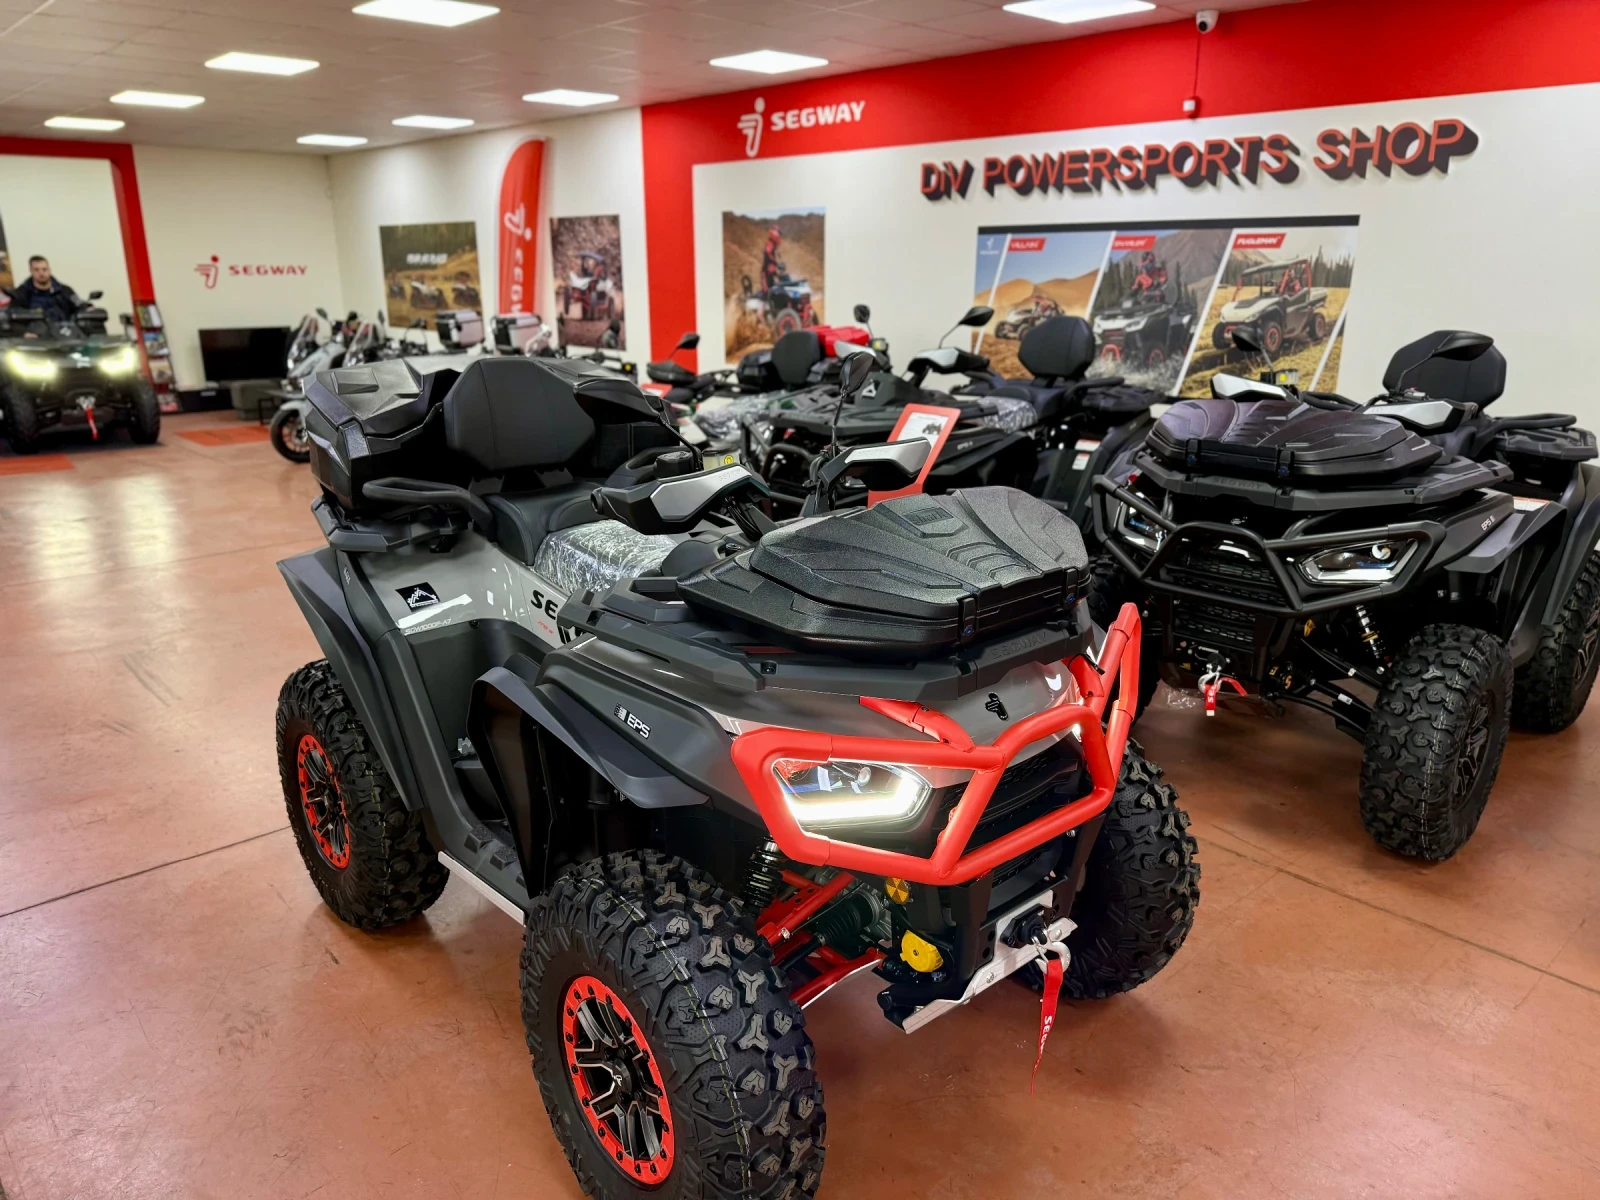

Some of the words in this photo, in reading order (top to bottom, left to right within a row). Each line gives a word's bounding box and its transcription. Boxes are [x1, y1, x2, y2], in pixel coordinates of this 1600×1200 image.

[769, 100, 866, 131] SEGWAY
[921, 159, 973, 199] DiV
[983, 134, 1299, 195] POWERSPORTS
[1313, 119, 1478, 181] SHOP
[228, 264, 308, 276] SEGWAY
[1481, 518, 1492, 530] EPS
[627, 713, 651, 738] EPS
